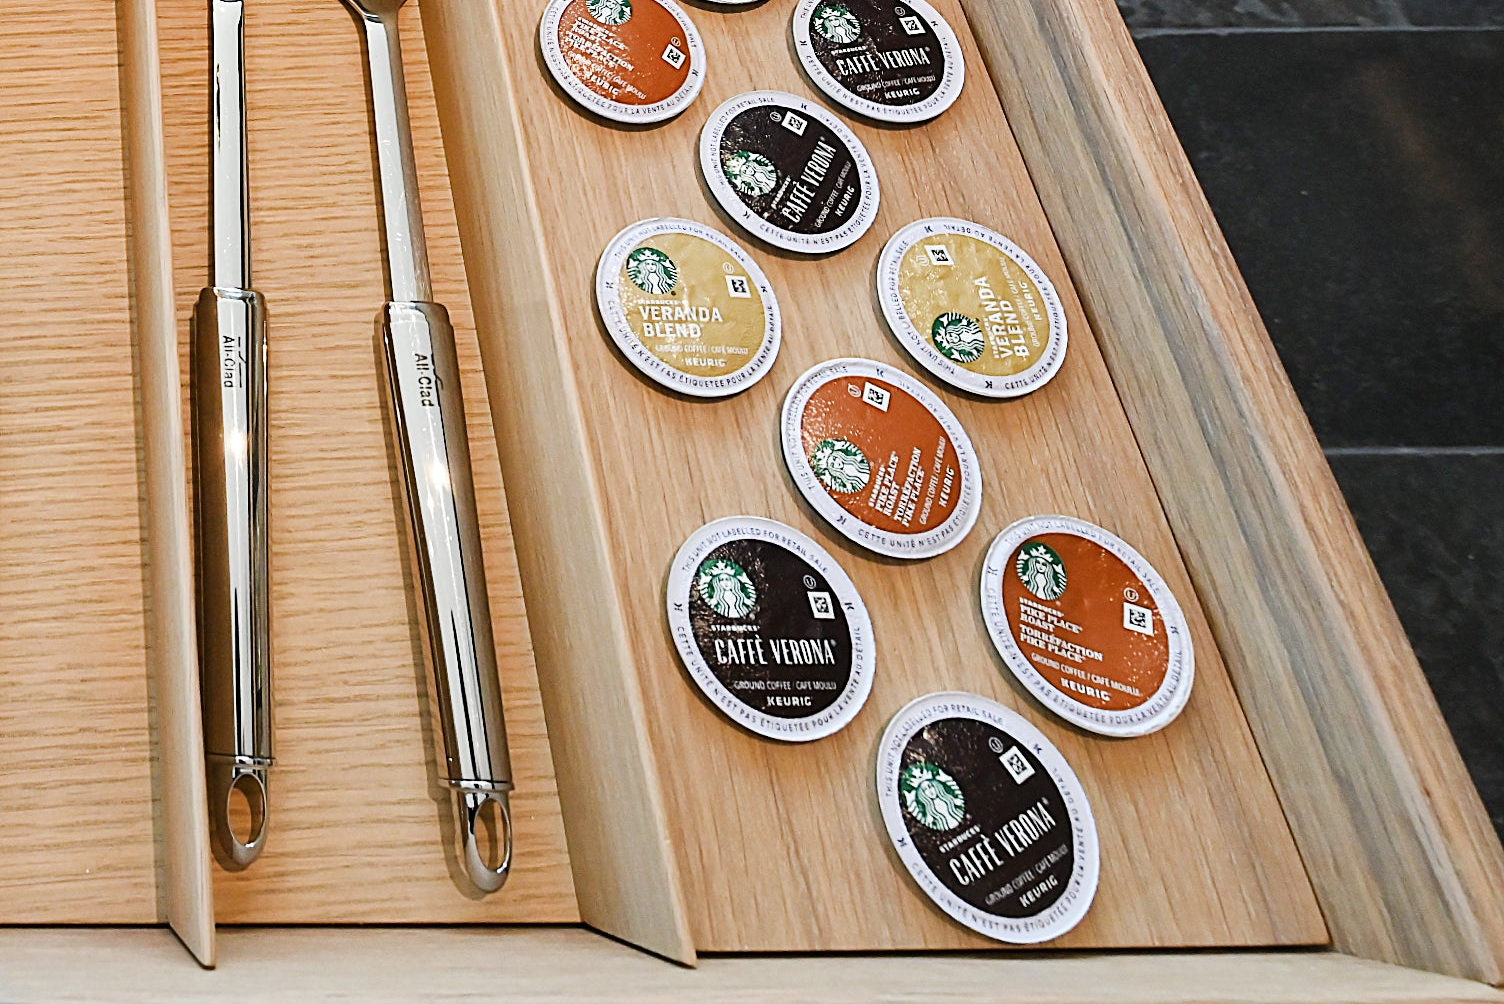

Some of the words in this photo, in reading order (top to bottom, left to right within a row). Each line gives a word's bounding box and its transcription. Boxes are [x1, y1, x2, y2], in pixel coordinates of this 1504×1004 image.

[836, 52, 880, 76] CAFFÈ
[880, 48, 931, 70] VERONA
[885, 88, 920, 99] KEURIG
[782, 181, 812, 223] CAFFÈ
[801, 140, 837, 187] VERONA
[835, 186, 856, 217] KEURIG
[639, 305, 724, 323] VERANDA
[973, 276, 1014, 357] VERANDA
[1020, 282, 1042, 321] KEURIG
[643, 322, 702, 338] BLEND
[1000, 301, 1030, 356] BLEND
[223, 336, 235, 388] All-Clad
[685, 358, 727, 367] KEURIG
[415, 353, 434, 407] All-Clad
[726, 372, 746, 386] POUR
[875, 485, 890, 512] PIKE
[883, 453, 900, 486] PLACE
[901, 500, 916, 527] PIKE
[909, 468, 926, 501] PLACE
[938, 466, 955, 508] KEURIG
[882, 481, 901, 517] ROAST
[682, 557, 695, 571] THIS
[695, 541, 707, 556] UNIT
[721, 527, 761, 538] LABELLED
[763, 530, 780, 540] FOR
[782, 536, 807, 556] RETAIL
[809, 554, 828, 573] SALE
[858, 528, 886, 545] CETTE
[941, 525, 954, 537] PAS
[1020, 604, 1046, 619] PIKE
[1048, 613, 1081, 634] PLACE
[1020, 613, 1056, 632] ROAST
[714, 634, 768, 665] CAFFÈ
[769, 639, 835, 665] VERONA
[1019, 624, 1104, 662] TORRÉFACTION
[1020, 633, 1046, 649] PIKE
[1048, 644, 1084, 663] PLACE
[677, 626, 694, 655] CETTE
[740, 708, 757, 723] PAS
[812, 712, 834, 726] POUR
[835, 704, 844, 715] LA
[1031, 652, 1060, 670] GROUND
[1060, 663, 1086, 680] COFFEE
[734, 680, 766, 690] GROUND
[766, 681, 791, 690] COFFEE
[1060, 677, 1111, 701] KEURIG
[766, 696, 812, 707] KEURIG
[950, 704, 980, 716] RETAIL
[982, 710, 1004, 725] SALE
[1033, 681, 1052, 697] PAS
[1110, 715, 1134, 724] POUR
[1136, 711, 1147, 721] LA
[949, 834, 1004, 886] CAFFÈ
[994, 801, 1057, 857] VERONA
[1019, 874, 1058, 908] KEURIG
[1002, 924, 1021, 933] PAS
